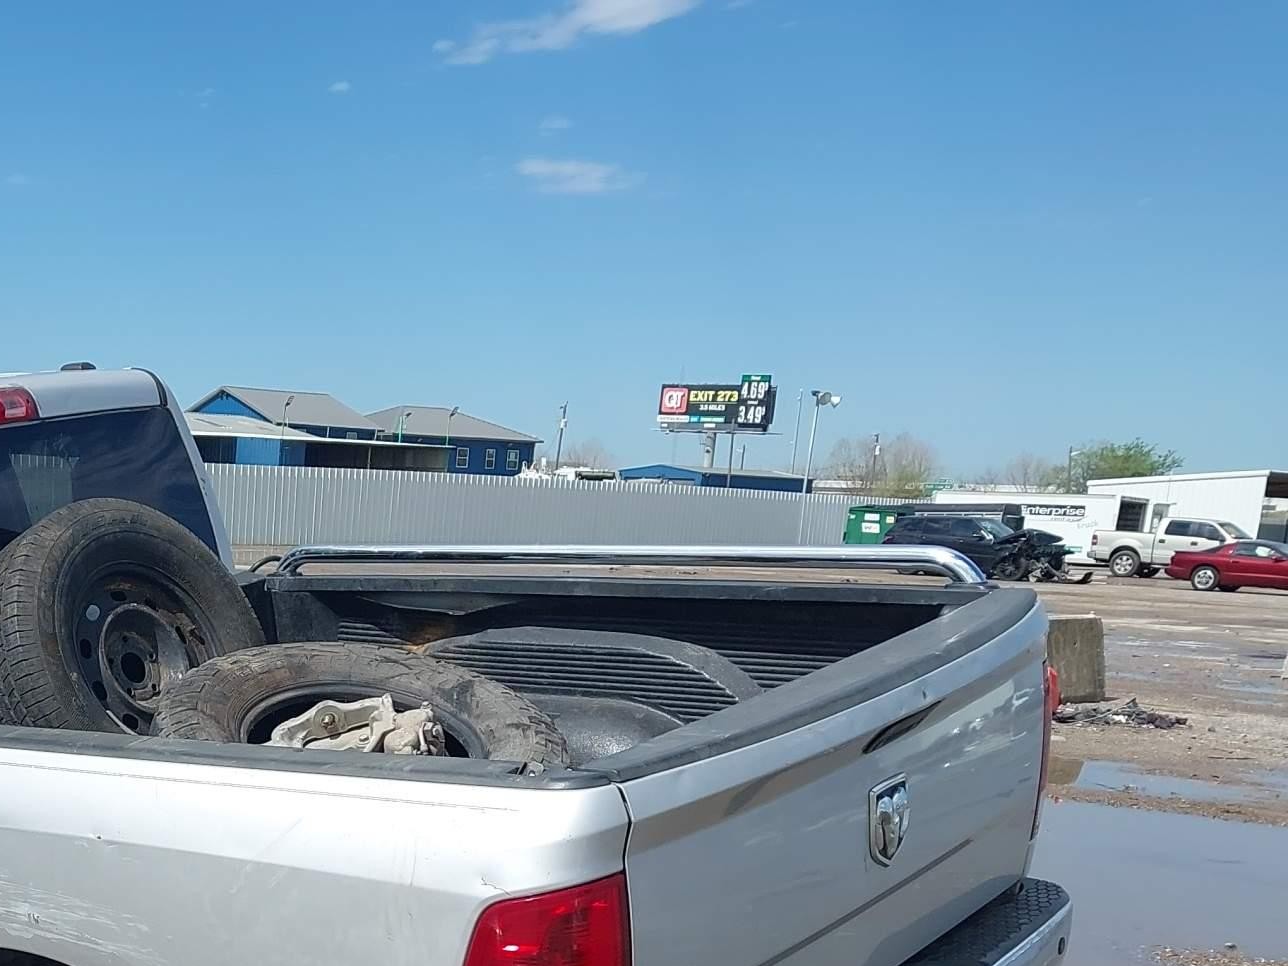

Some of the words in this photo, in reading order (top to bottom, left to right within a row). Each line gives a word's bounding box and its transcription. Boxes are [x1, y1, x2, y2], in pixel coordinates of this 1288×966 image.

[665, 391, 685, 409] QT
[689, 391, 715, 402] EXIT
[716, 391, 739, 402] 273
[1021, 505, 1085, 517] Enterprise
